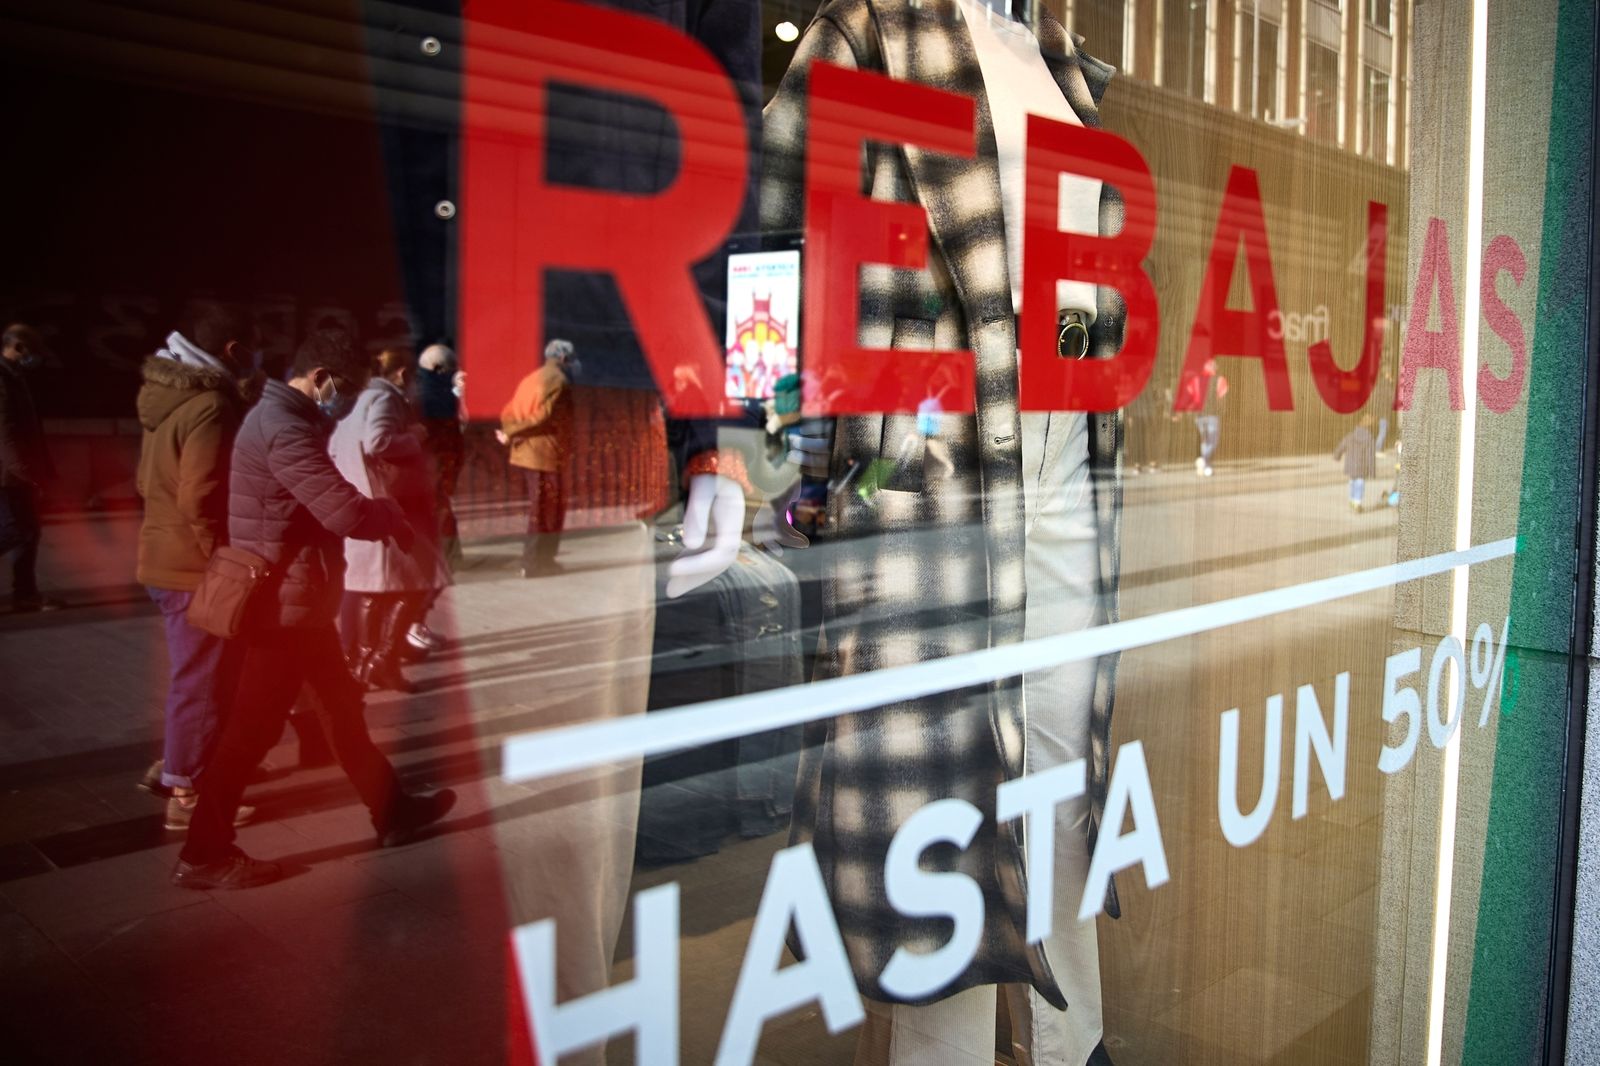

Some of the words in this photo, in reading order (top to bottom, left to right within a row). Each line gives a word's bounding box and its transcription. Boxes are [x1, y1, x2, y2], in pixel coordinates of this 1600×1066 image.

[460, 0, 1527, 418] REBAJAS
[514, 740, 1170, 1066] HASTA
[1218, 671, 1350, 848] UN
[1377, 615, 1521, 774] 50%
